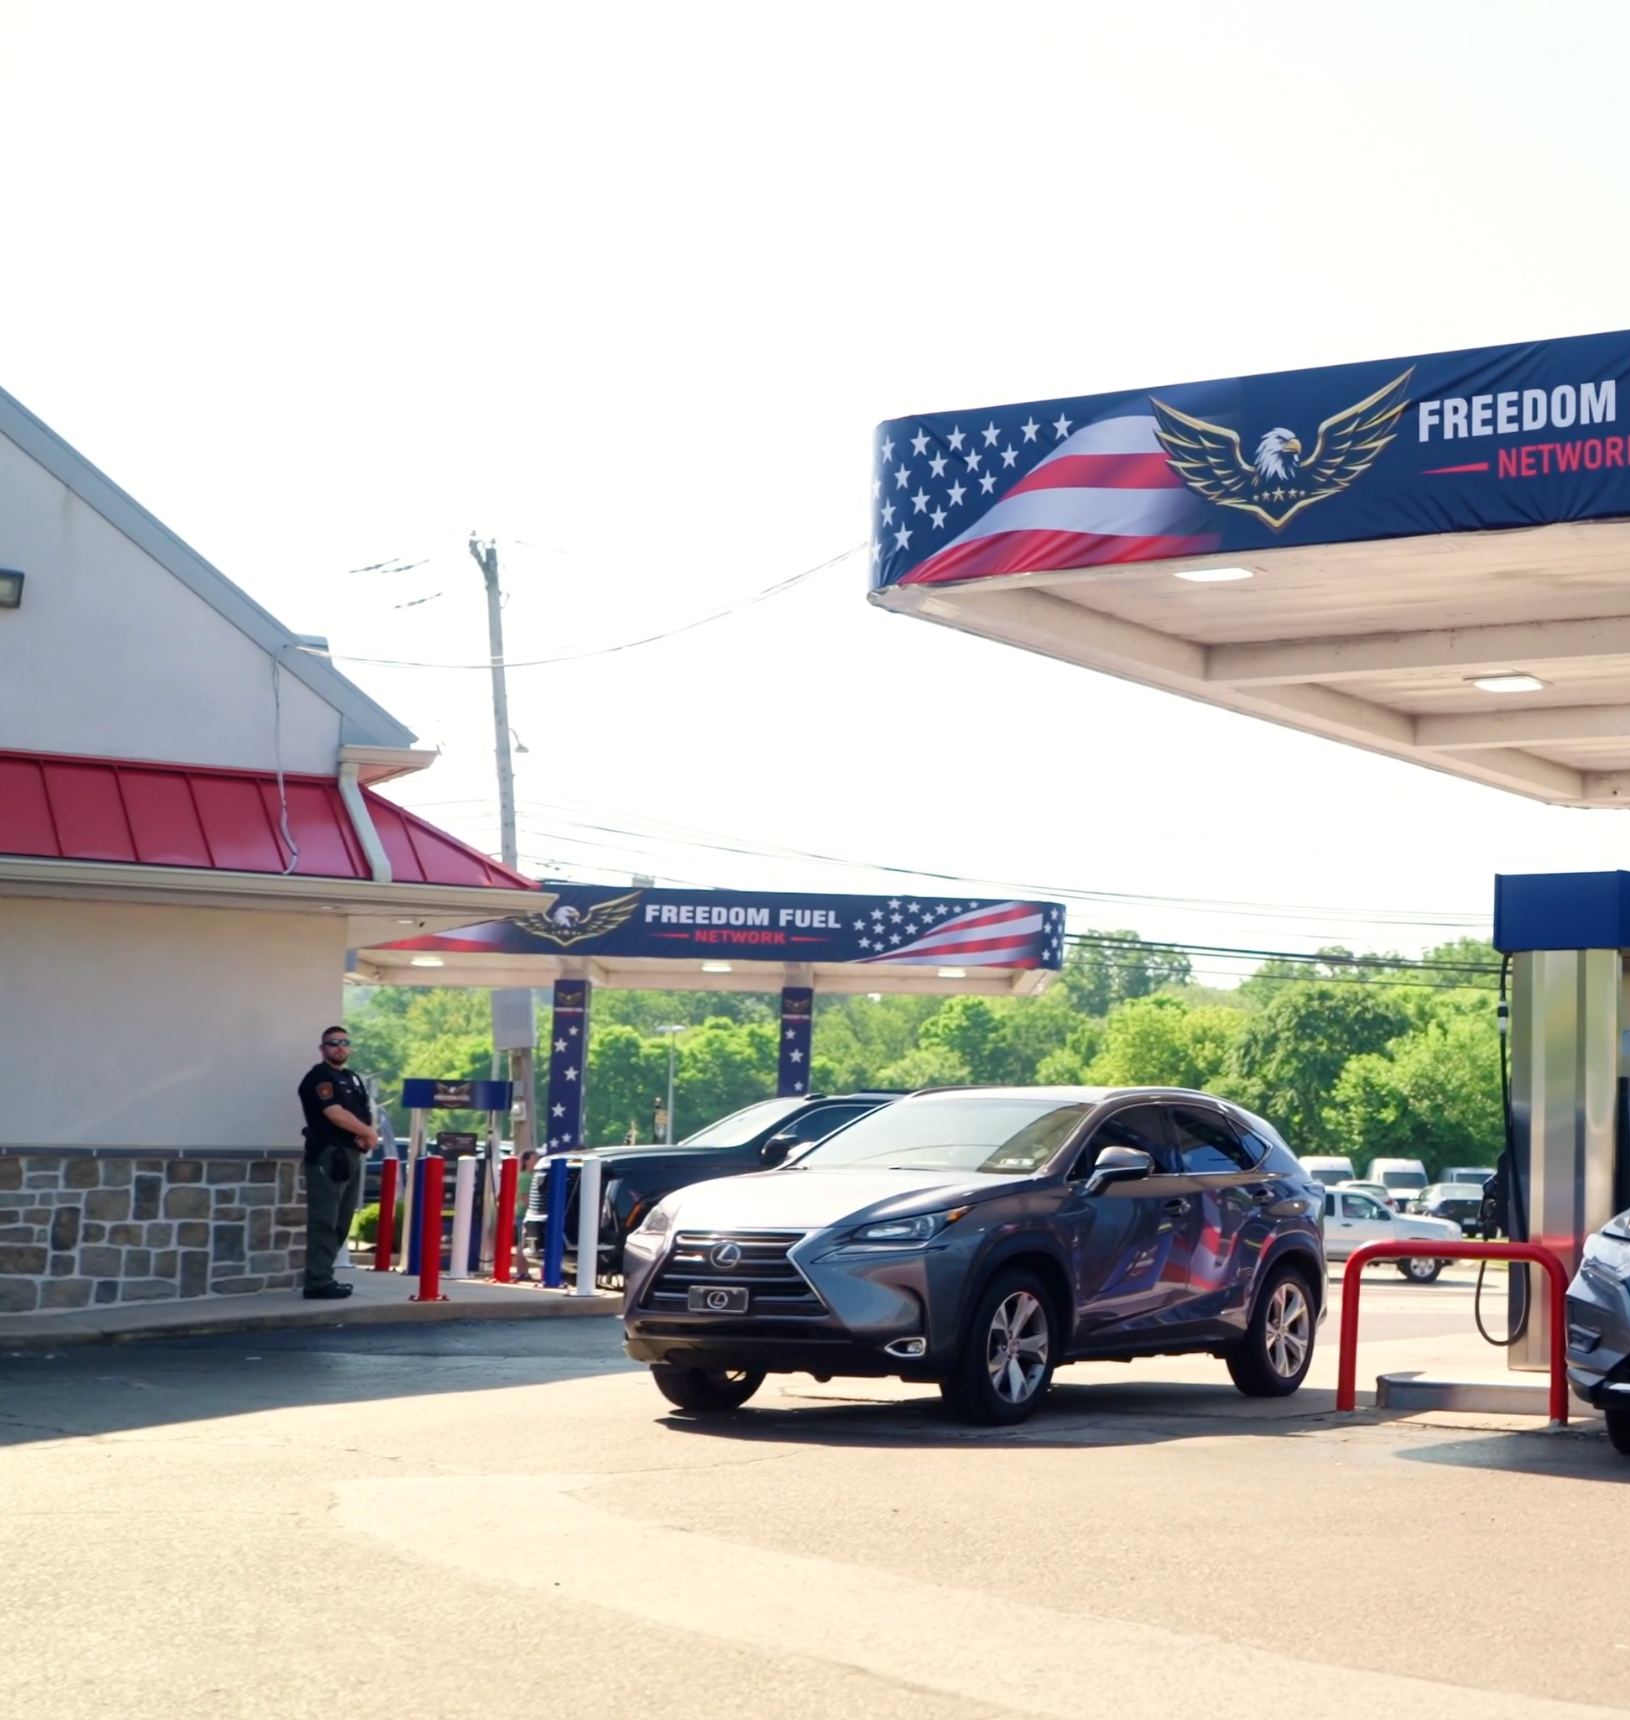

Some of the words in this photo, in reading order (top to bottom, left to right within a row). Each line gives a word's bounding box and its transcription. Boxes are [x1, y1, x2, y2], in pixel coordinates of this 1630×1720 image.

[1418, 379, 1616, 442] FREEDOM
[645, 904, 770, 926] FREEDOM
[778, 908, 841, 928] FUEL
[694, 930, 786, 944] NETWORK
